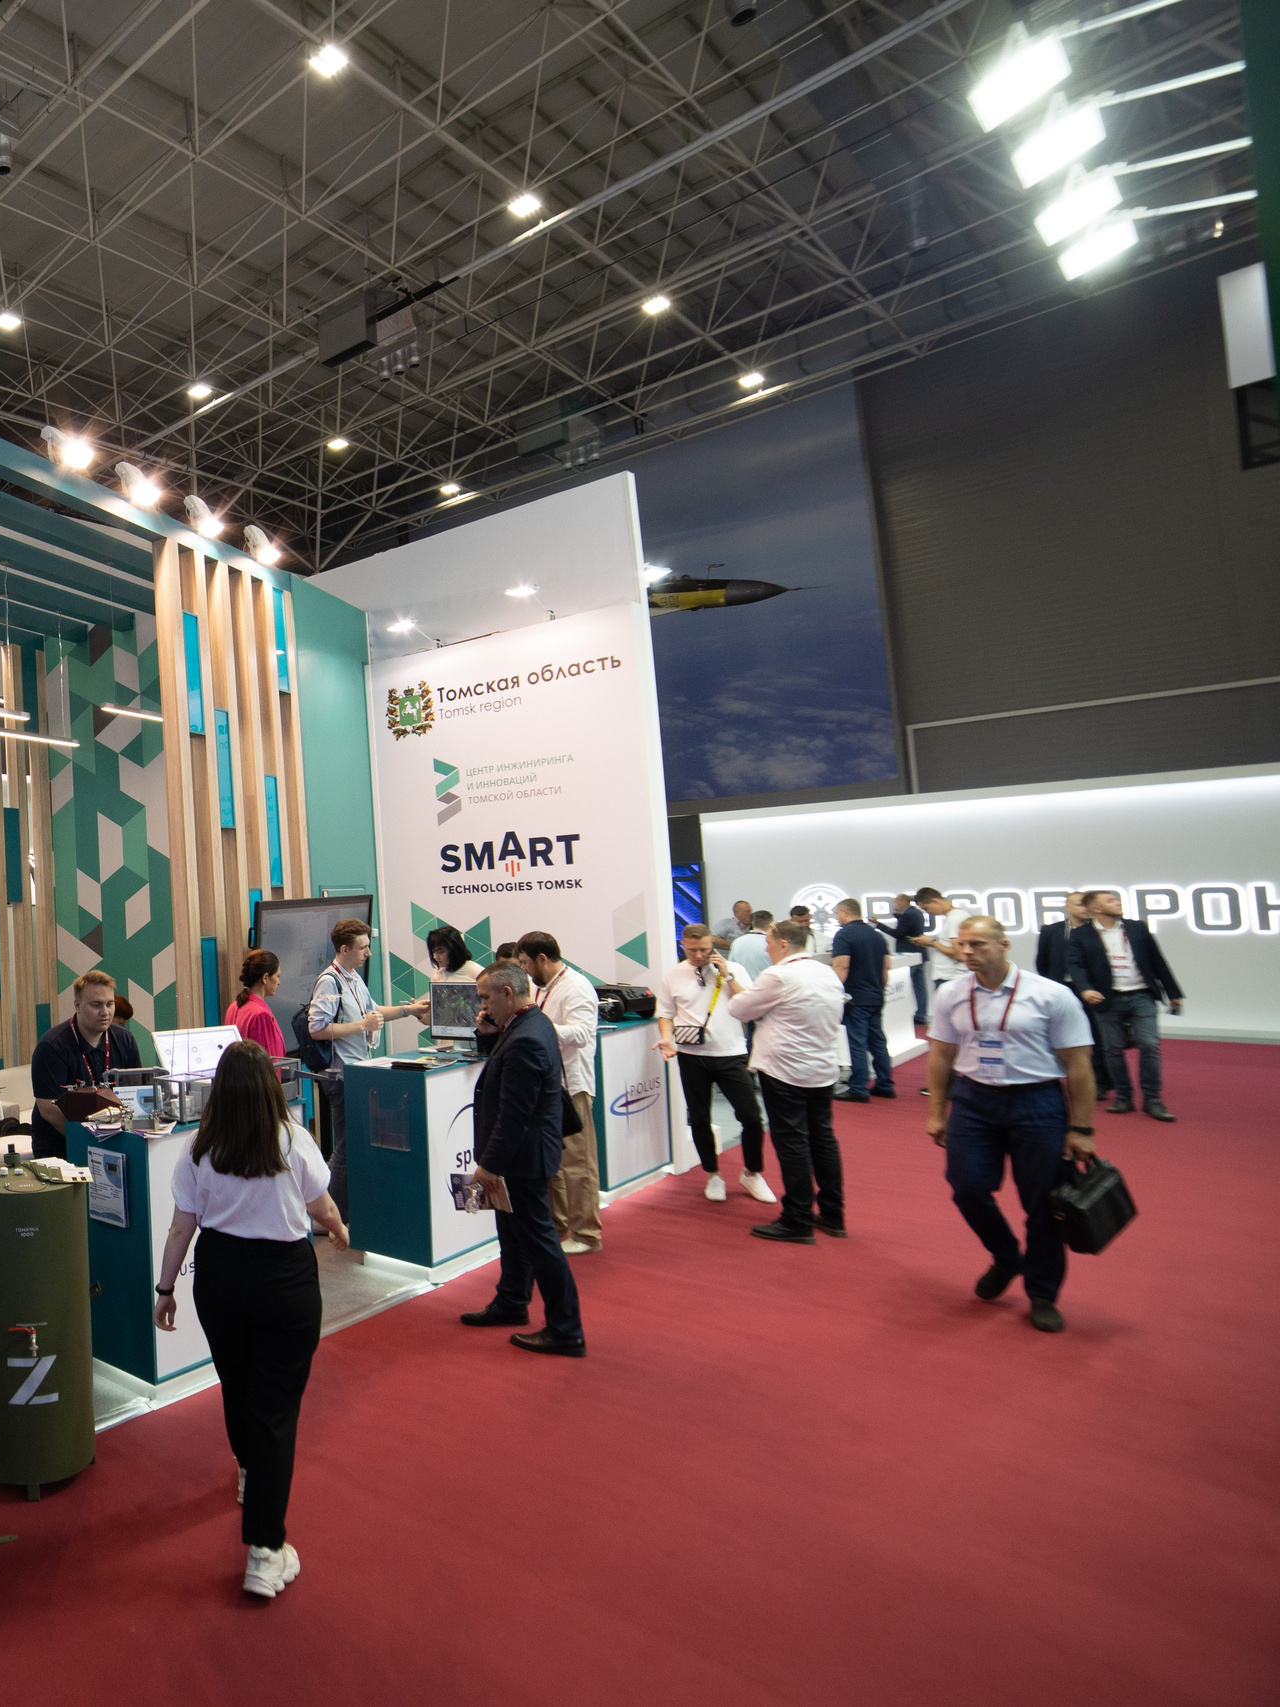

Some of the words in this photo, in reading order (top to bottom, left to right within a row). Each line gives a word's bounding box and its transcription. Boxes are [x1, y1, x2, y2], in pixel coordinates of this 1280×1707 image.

[437, 675, 520, 703] Томская
[527, 655, 622, 685] область
[439, 703, 477, 720] Tomsk
[479, 696, 522, 713] region
[465, 765, 494, 778] ЦЕНТР
[496, 754, 574, 773] ИНЖИНИРИНГА
[466, 782, 474, 791] И
[476, 772, 538, 790] ИННОВАЦИЙ
[468, 790, 514, 805] ТОМСКОЙ
[516, 786, 562, 799] ОБЛАСТИ
[440, 831, 580, 873] SMART
[441, 881, 533, 895] TECHNOLOGIES
[536, 878, 583, 890] TOMSK
[630, 1076, 661, 1097] POLUS
[7, 1354, 59, 1405] Z
